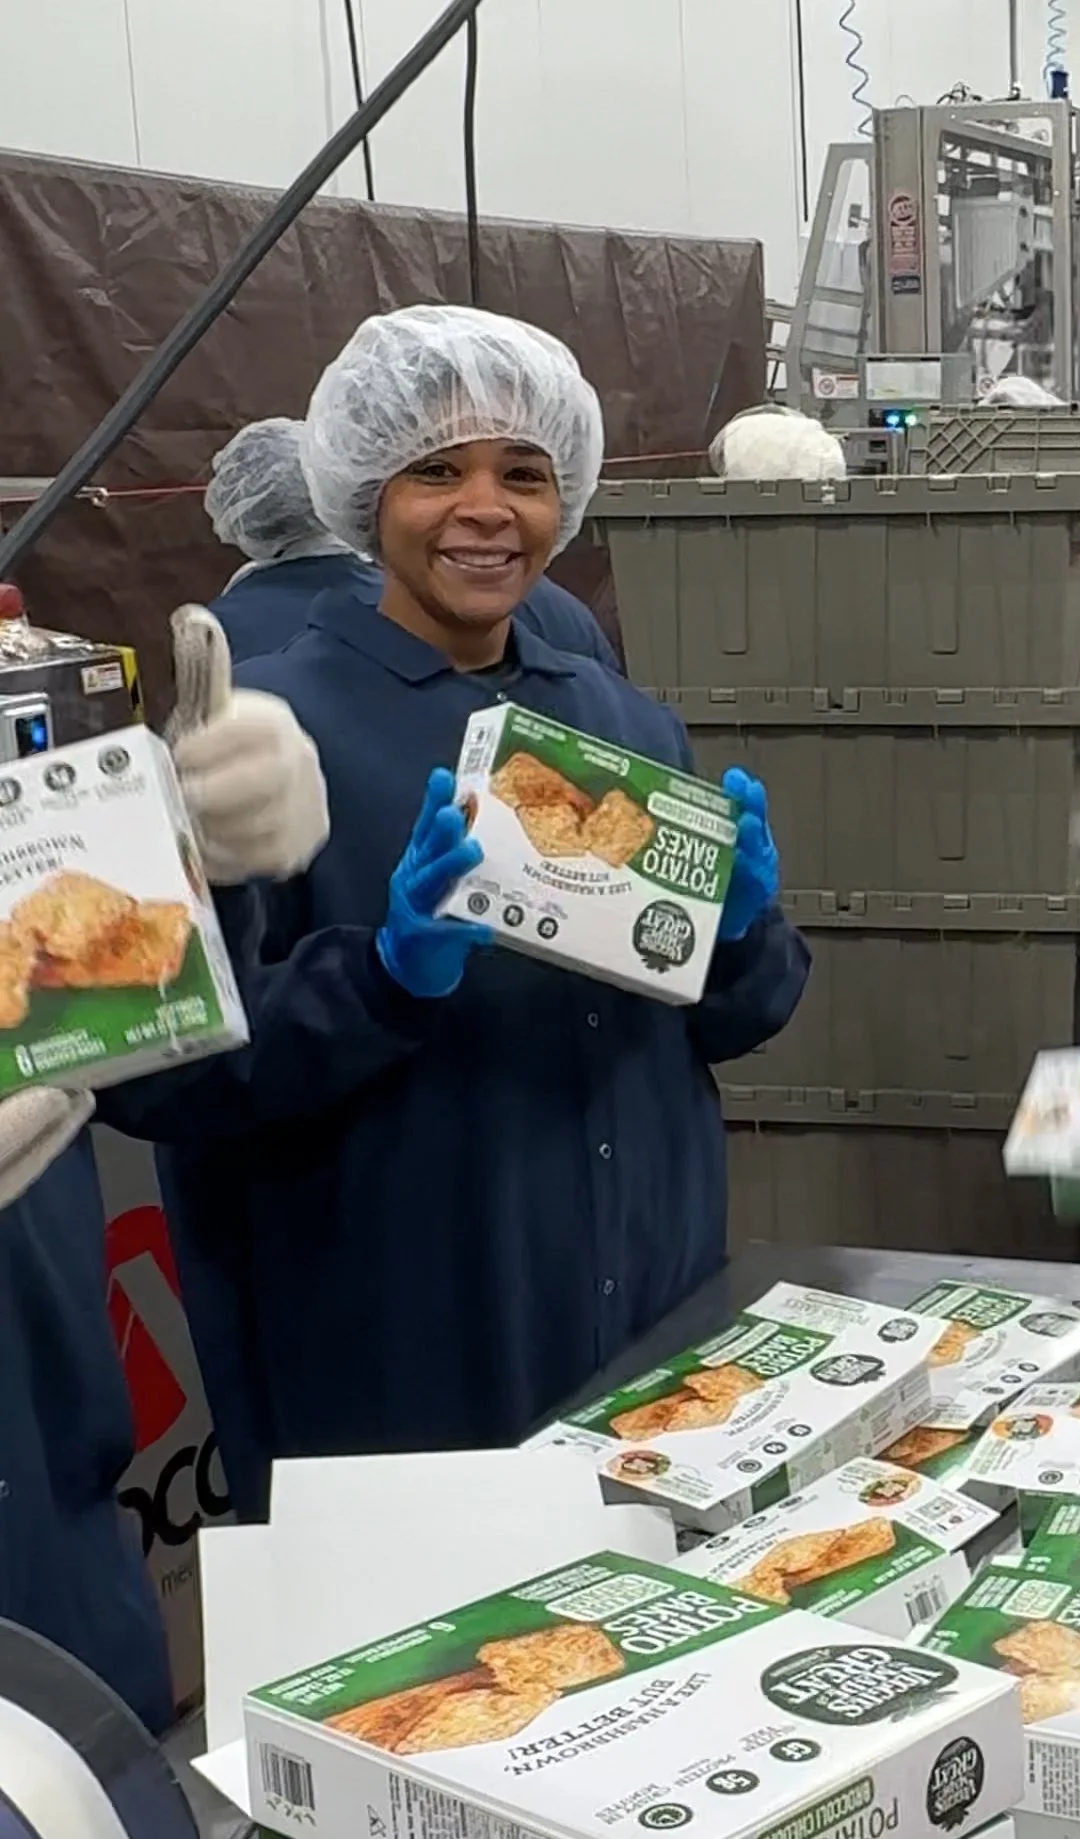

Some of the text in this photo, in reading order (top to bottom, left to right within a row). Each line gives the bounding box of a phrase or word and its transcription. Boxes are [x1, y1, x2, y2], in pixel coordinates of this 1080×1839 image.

[653, 825, 719, 870] BAKES
[642, 849, 720, 898] POTATO
[755, 1336, 827, 1377] POTATO
[602, 1590, 711, 1639] BAKES
[619, 1596, 769, 1655] POTATO
[768, 1647, 893, 1703] GREAT
[826, 1665, 944, 1719] VEGGIES
[503, 1708, 668, 1776] HASHBROWN,
[507, 1679, 675, 1760] BUT BETTER!
[674, 1755, 737, 1787] PROTEIN
[780, 1741, 812, 1759] GF
[932, 1747, 978, 1790] GREAT
[712, 1772, 751, 1790] 5g
[811, 1783, 871, 1831] BROCCOLI
